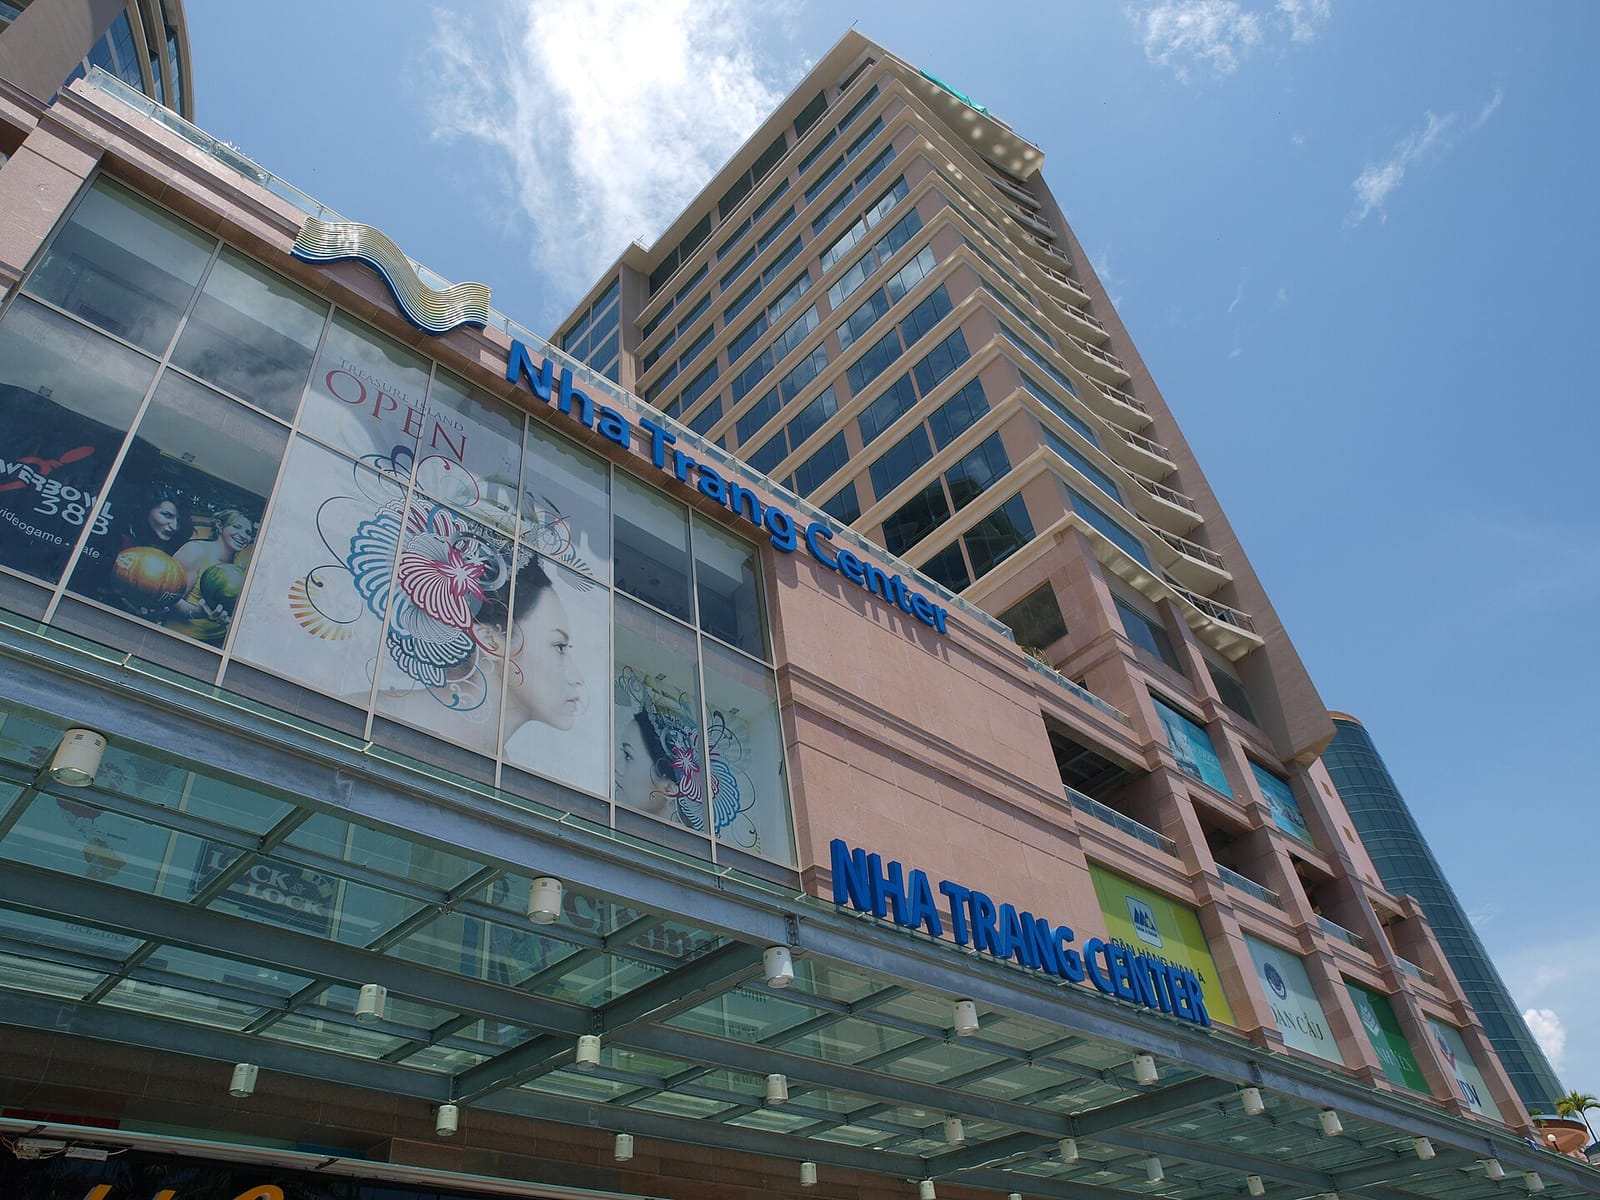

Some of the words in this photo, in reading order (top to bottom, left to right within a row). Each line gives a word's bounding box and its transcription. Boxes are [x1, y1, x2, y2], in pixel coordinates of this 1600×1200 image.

[325, 369, 468, 463] OPEN
[338, 359, 410, 402] TREASURE
[414, 399, 464, 432] ISLAND
[505, 339, 631, 449] Nha
[639, 418, 798, 553] Trang
[805, 522, 949, 635] Center
[206, 850, 291, 890] LCK
[244, 881, 323, 917] LOCK
[829, 838, 943, 937] NHA
[938, 879, 1085, 983] TRANG
[1082, 937, 1213, 1028] CENTER
